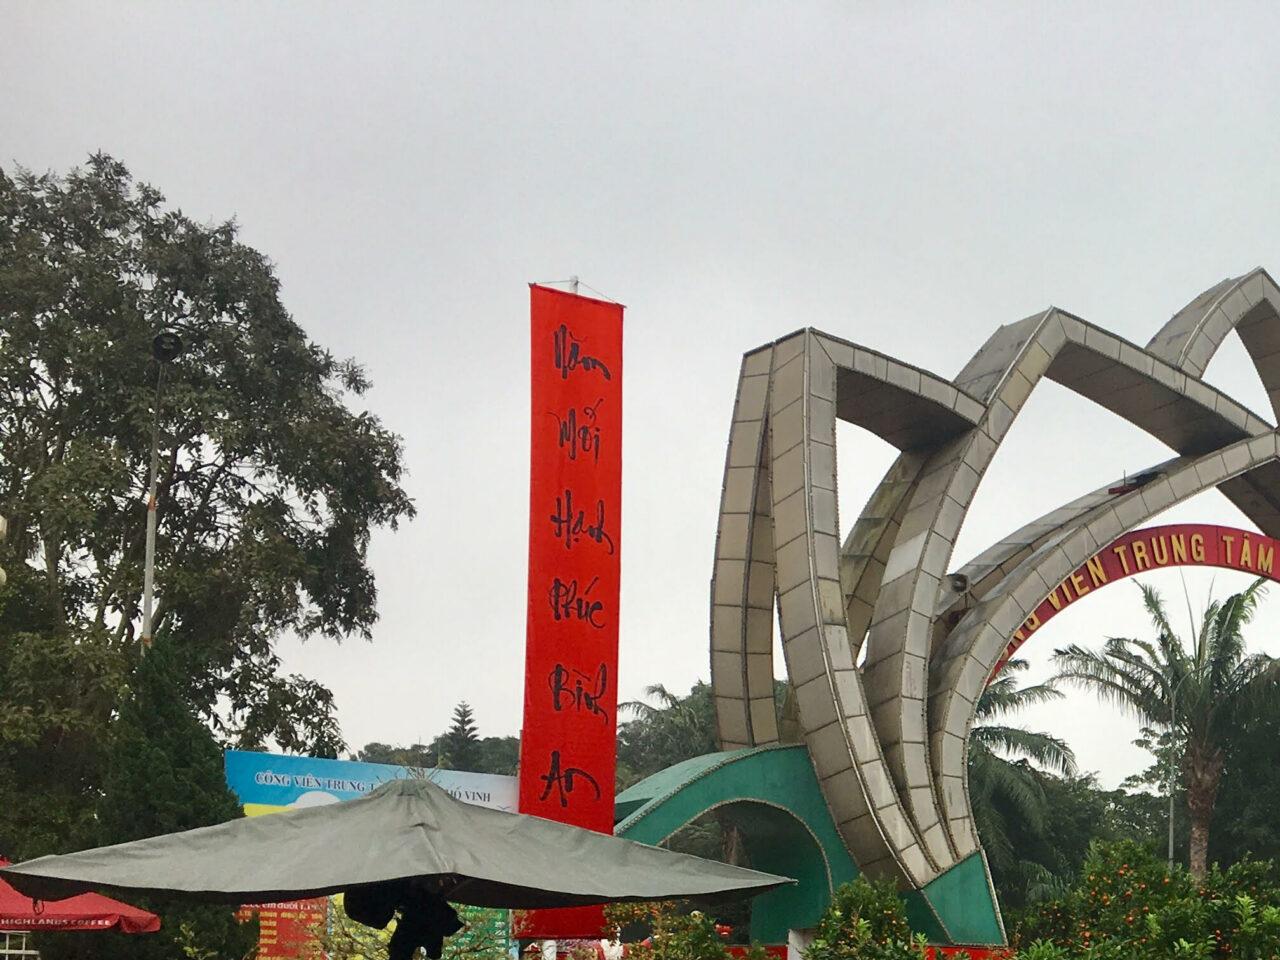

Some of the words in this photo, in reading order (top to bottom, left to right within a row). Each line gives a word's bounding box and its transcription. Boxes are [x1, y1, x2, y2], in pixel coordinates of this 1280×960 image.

[1113, 533, 1206, 575] TRUNG
[1223, 533, 1275, 574] TÂM
[255, 770, 291, 787] CÔNG
[293, 773, 322, 789] VIÊN
[326, 778, 366, 793] TRUNG
[464, 789, 491, 802] VINH
[1, 918, 67, 926] HIGHLANDS
[70, 918, 112, 926] COFFEE
